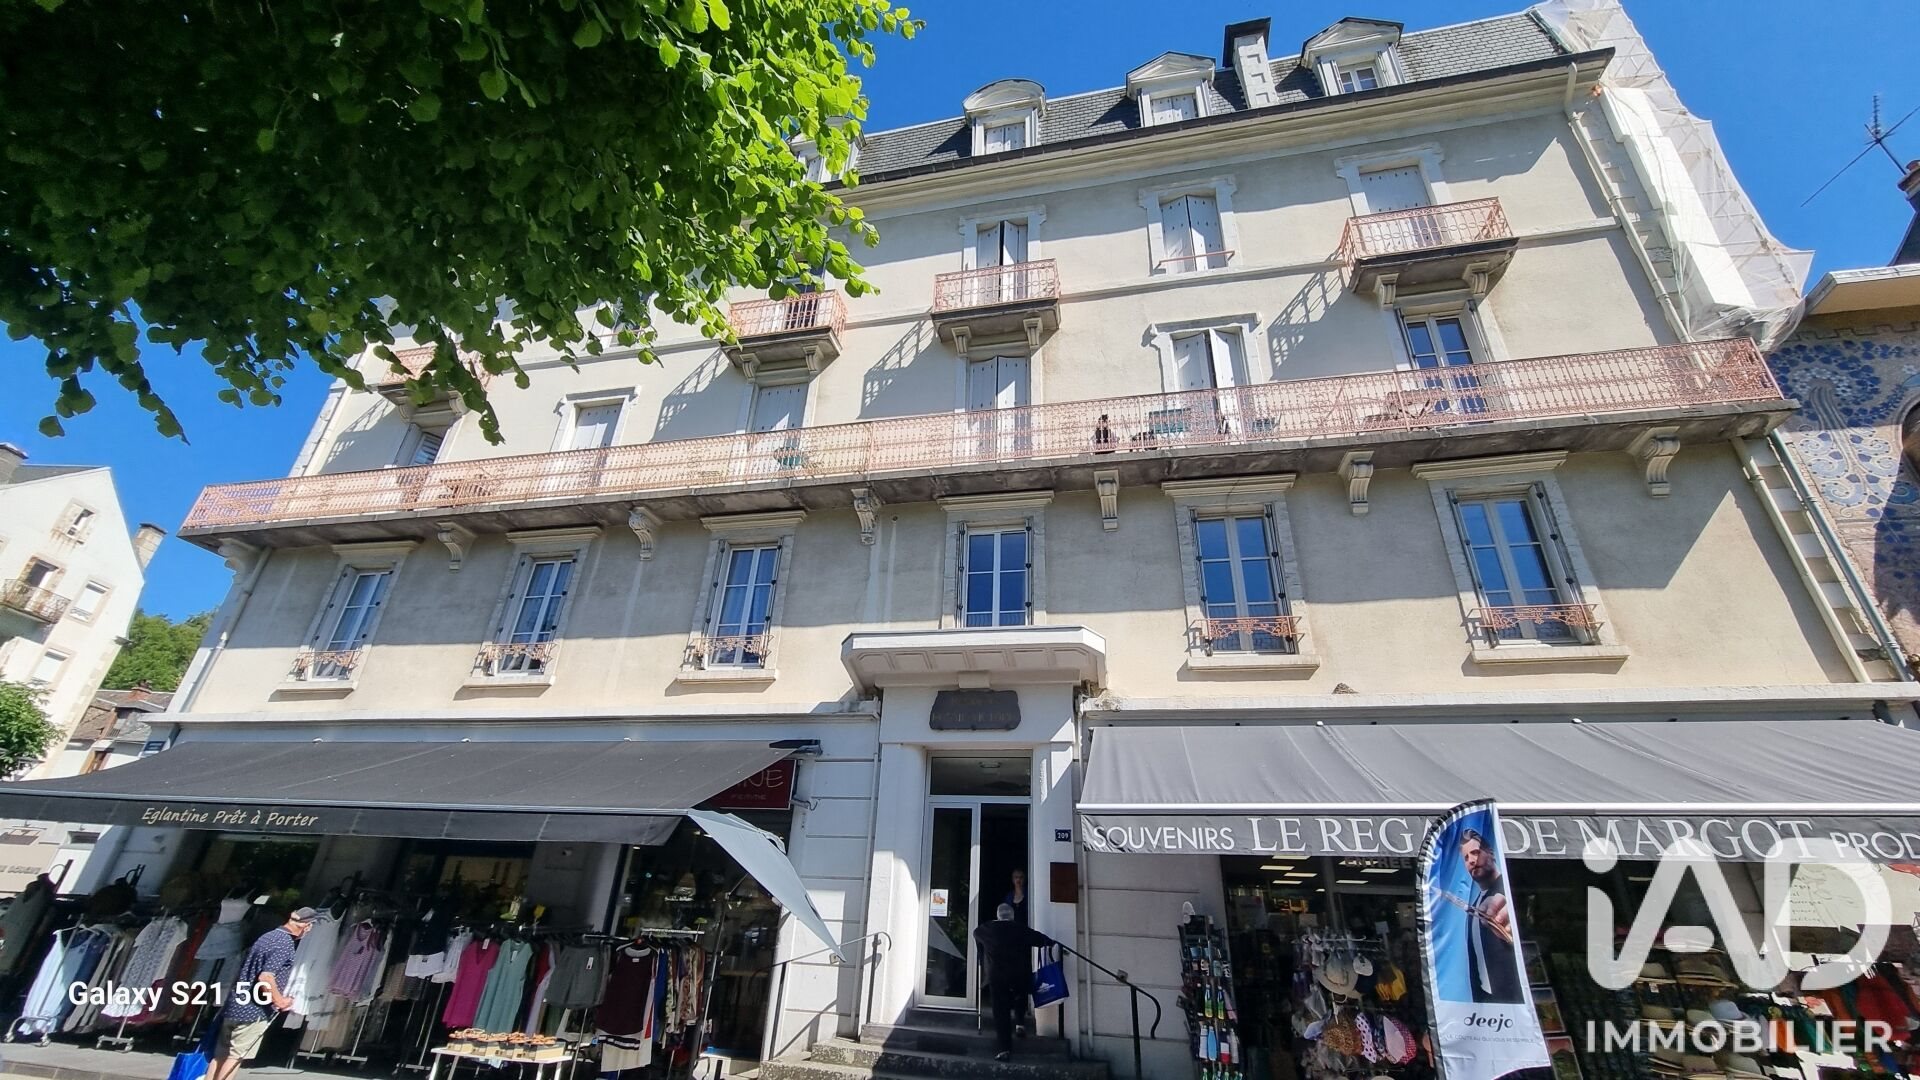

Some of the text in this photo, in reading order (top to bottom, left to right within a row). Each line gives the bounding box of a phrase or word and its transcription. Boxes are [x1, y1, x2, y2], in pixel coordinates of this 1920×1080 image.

[141, 806, 319, 827] Eglantine Prêt à Porter
[1093, 825, 1235, 850] SOUVENIRS
[1247, 817, 1307, 853] LE
[1314, 817, 1432, 854] REG
[1500, 818, 1567, 855] DE
[1572, 818, 1818, 859] MARGOT
[1463, 1012, 1514, 1033] deejo
